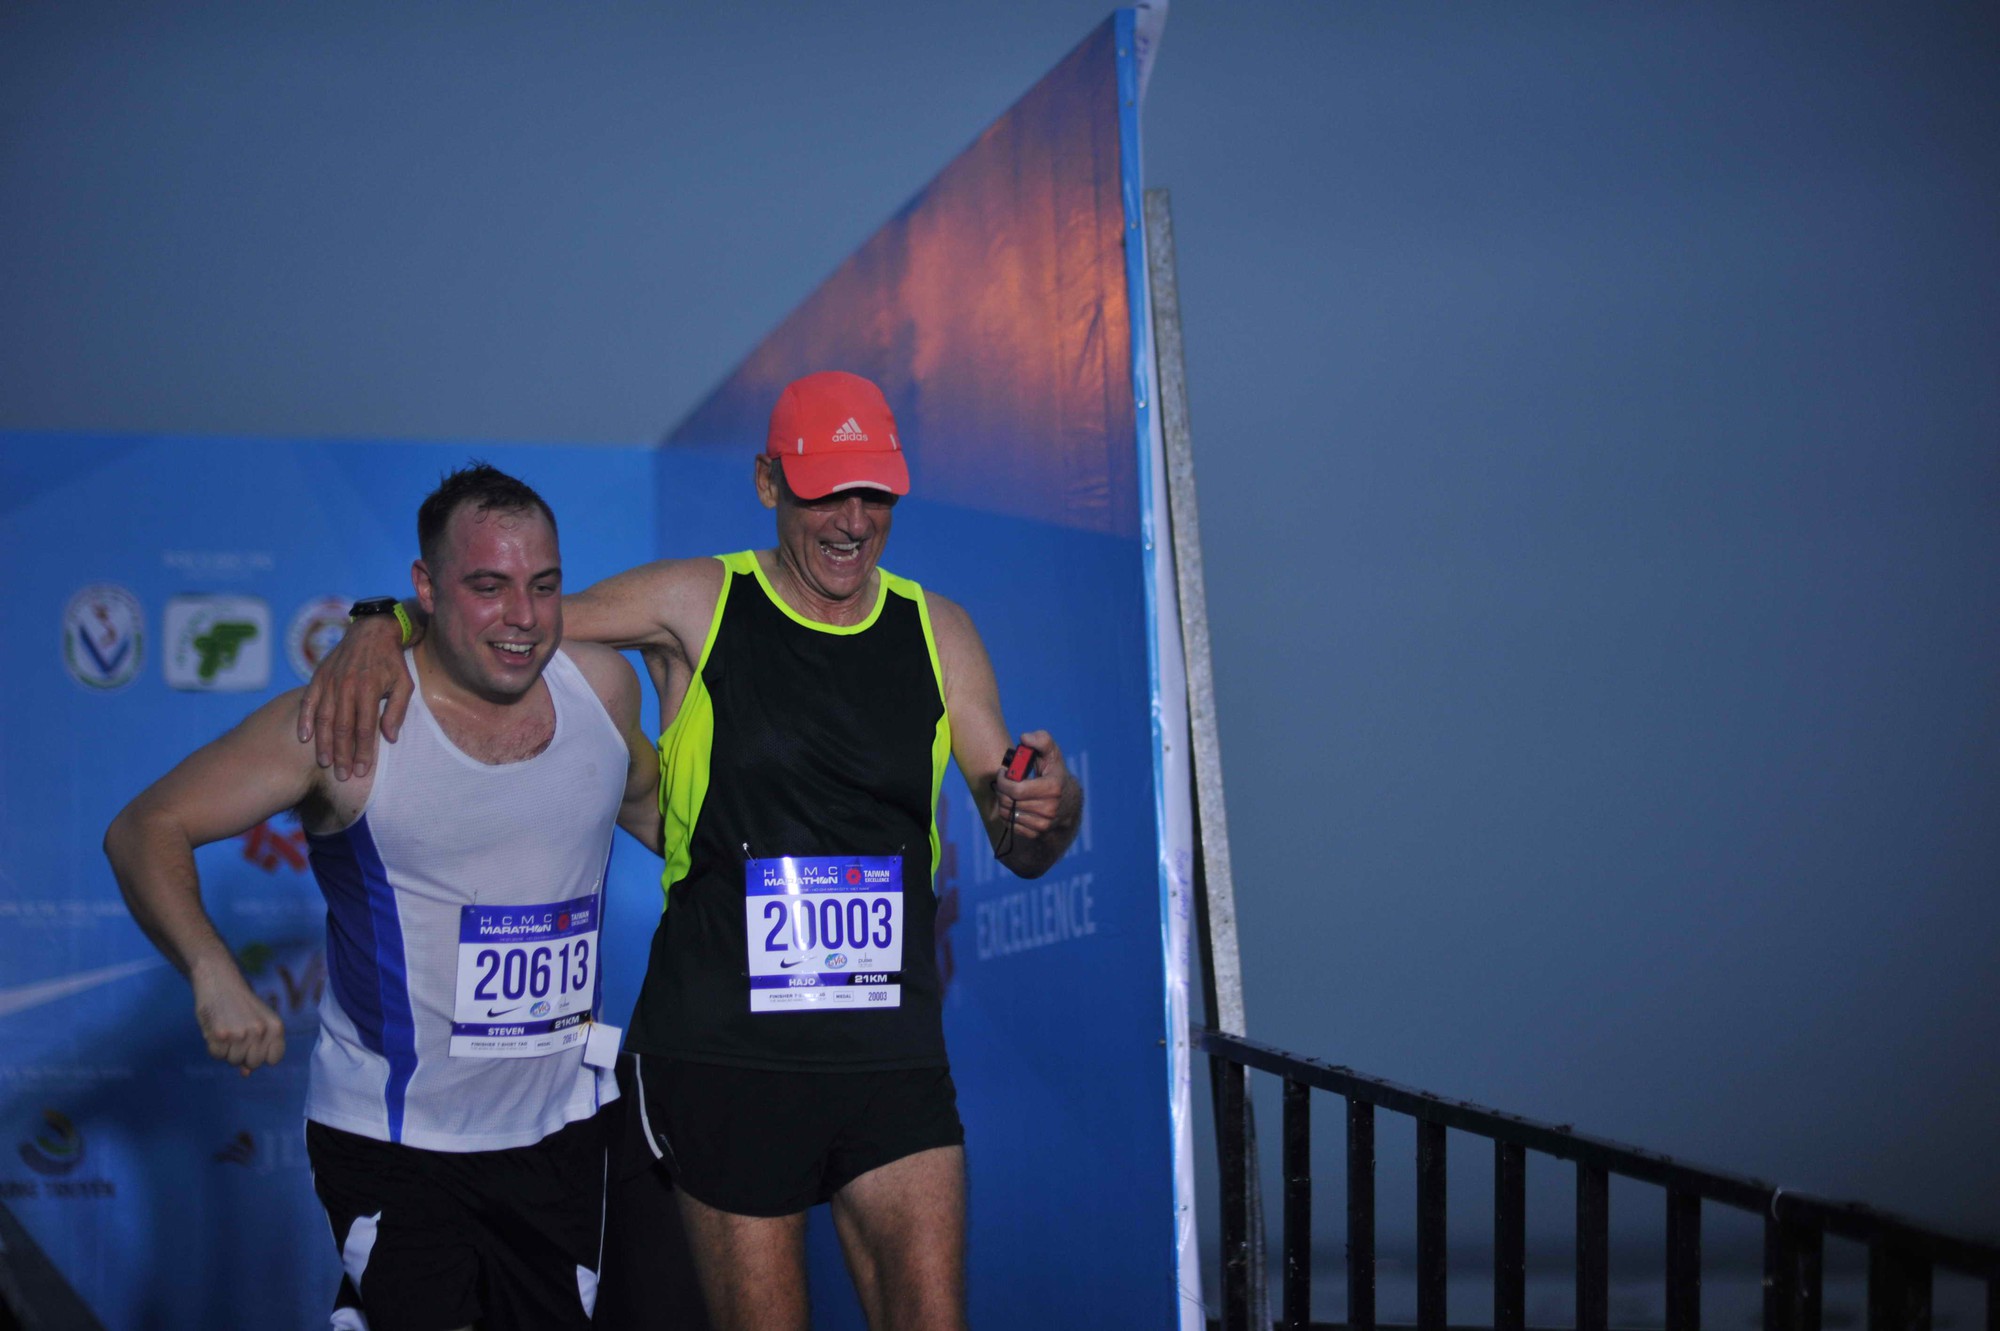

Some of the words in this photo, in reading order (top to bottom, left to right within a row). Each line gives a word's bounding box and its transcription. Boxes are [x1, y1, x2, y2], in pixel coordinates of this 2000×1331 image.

[832, 432, 868, 442] adidas
[863, 869, 890, 877] TAIWAN
[977, 872, 1095, 960] EXCELLENCE
[480, 924, 552, 935] MARATHON
[763, 897, 892, 952] 20003
[474, 939, 589, 1001] 20613
[854, 974, 888, 983] 21KM
[868, 991, 888, 1002] 20003
[488, 1027, 524, 1036] STEVEN
[555, 1015, 580, 1029] 21KM
[562, 1032, 579, 1045] 20613
